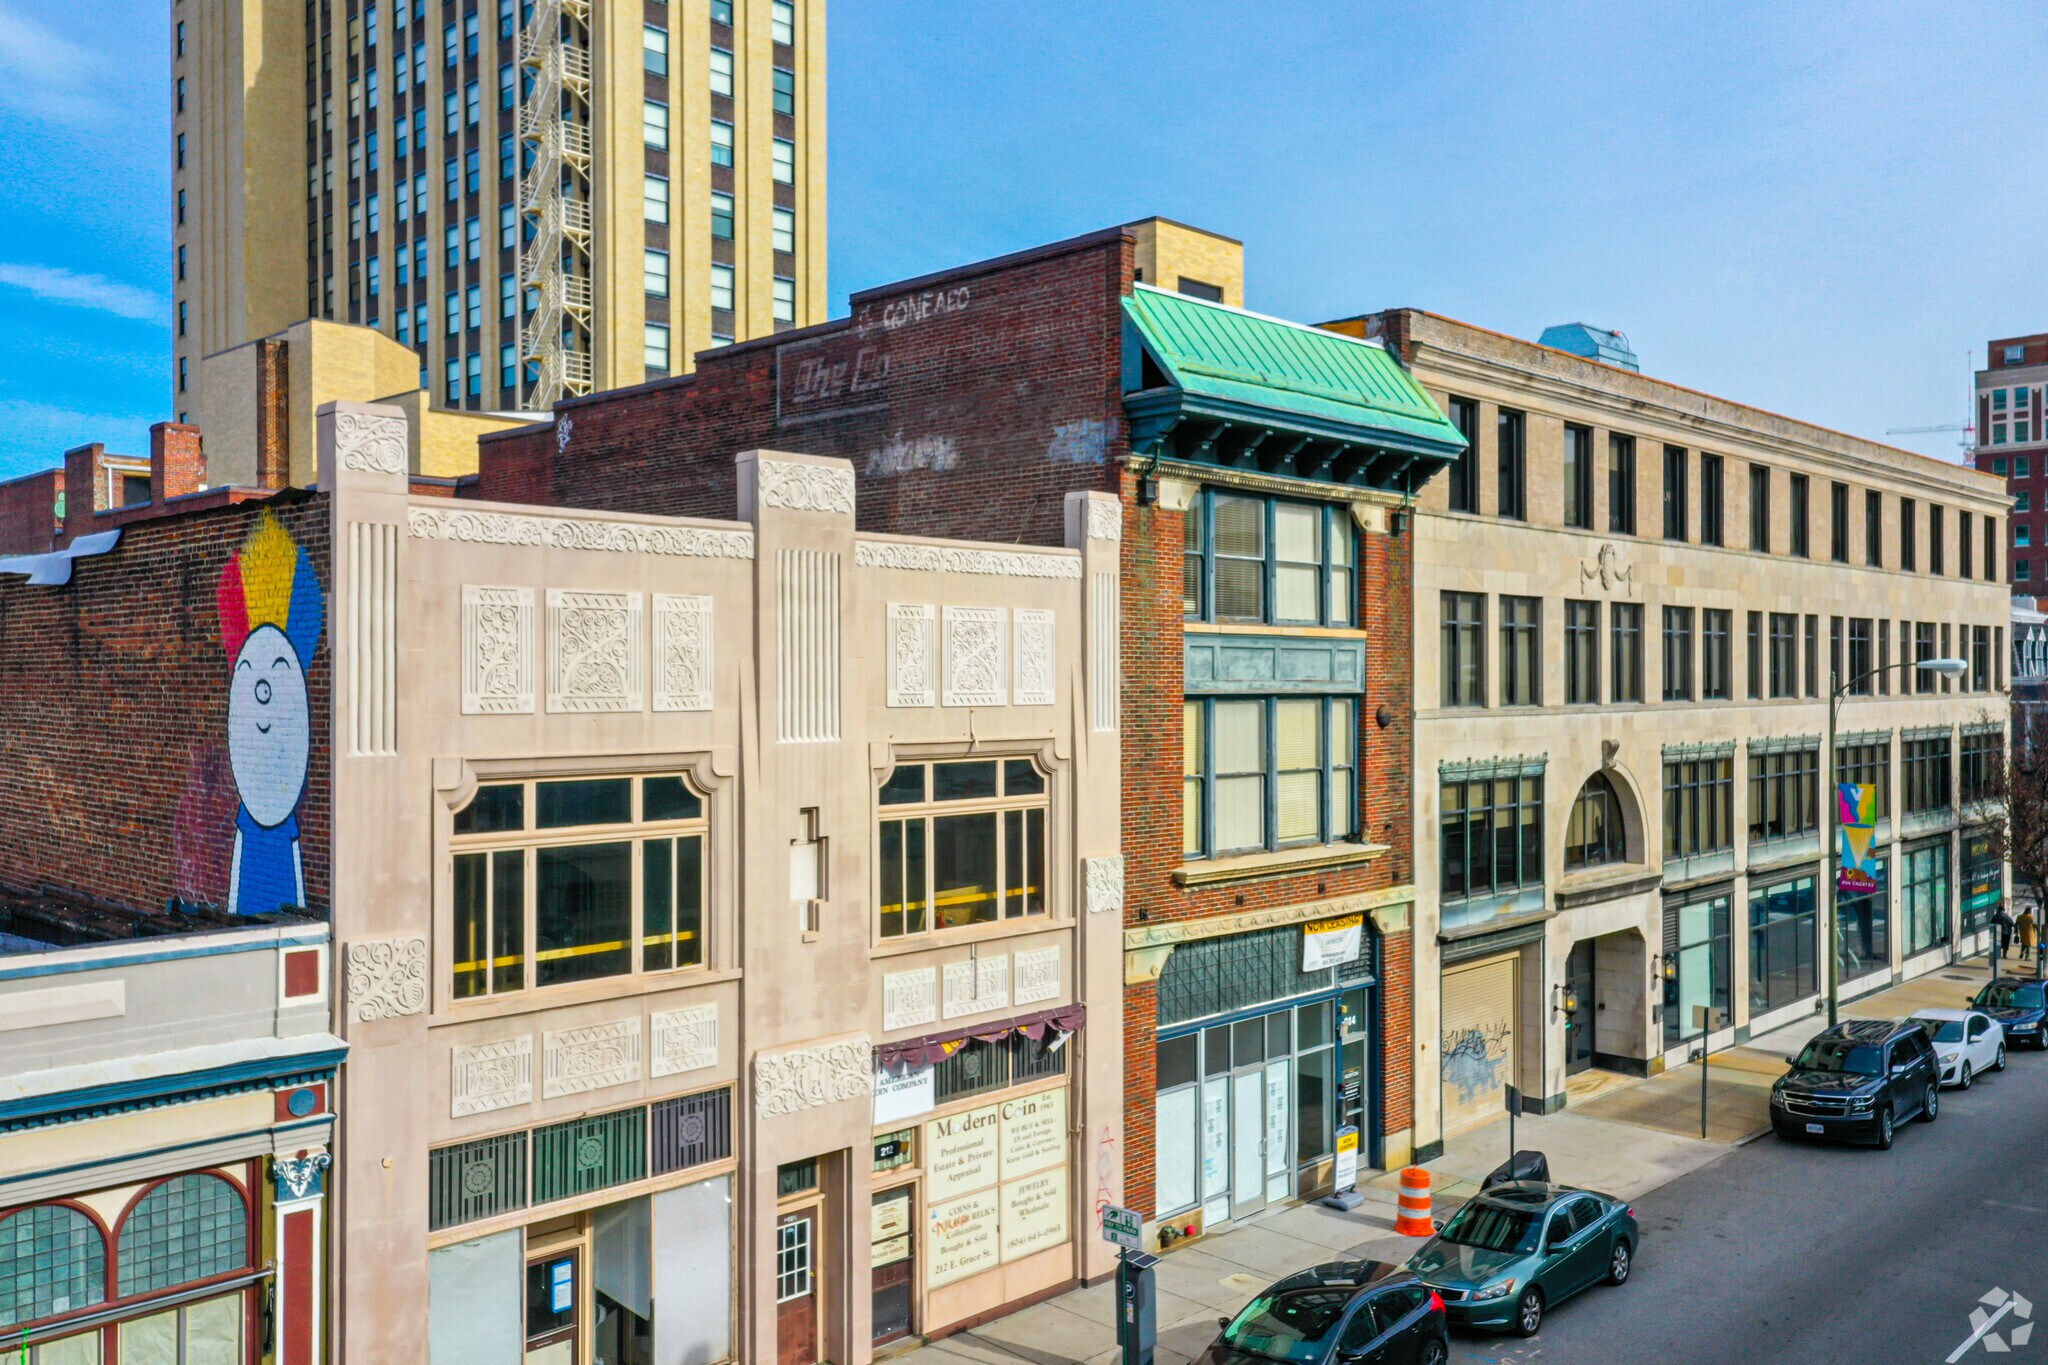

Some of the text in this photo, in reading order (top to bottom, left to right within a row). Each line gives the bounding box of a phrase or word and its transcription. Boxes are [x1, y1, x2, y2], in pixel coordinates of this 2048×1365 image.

[1852, 880, 1874, 888] CREATES
[1306, 922, 1325, 932] NOW
[879, 1070, 920, 1087] AMERICAN
[892, 1077, 929, 1092] COMPANY
[936, 1100, 1036, 1139] Modern Coin
[1021, 1122, 1034, 1132] BUY
[1022, 1132, 1032, 1141] and
[1033, 1127, 1052, 1138] Foreign
[880, 1145, 894, 1157] 212
[940, 1137, 984, 1158] Professional
[1010, 1145, 1026, 1154] Coins
[1032, 1136, 1056, 1147] Currency
[1022, 1149, 1034, 1159] Gold
[1041, 1143, 1061, 1154] Sterling
[933, 1148, 994, 1174] Estate & Private
[947, 1164, 981, 1183] Appraisal
[1018, 1179, 1050, 1196] JEWELRY
[1011, 1187, 1057, 1209] Bought & Sold
[948, 1200, 980, 1217] COINS &
[971, 1206, 997, 1221] RELICS
[1018, 1201, 1050, 1218] Wholesale
[946, 1222, 982, 1240] Collectibles
[1104, 1220, 1138, 1235] PAY TO PARK
[940, 1232, 988, 1255] Bought & Sold
[935, 1262, 948, 1275] 212
[949, 1259, 958, 1270] E.
[959, 1252, 981, 1267] Grace
